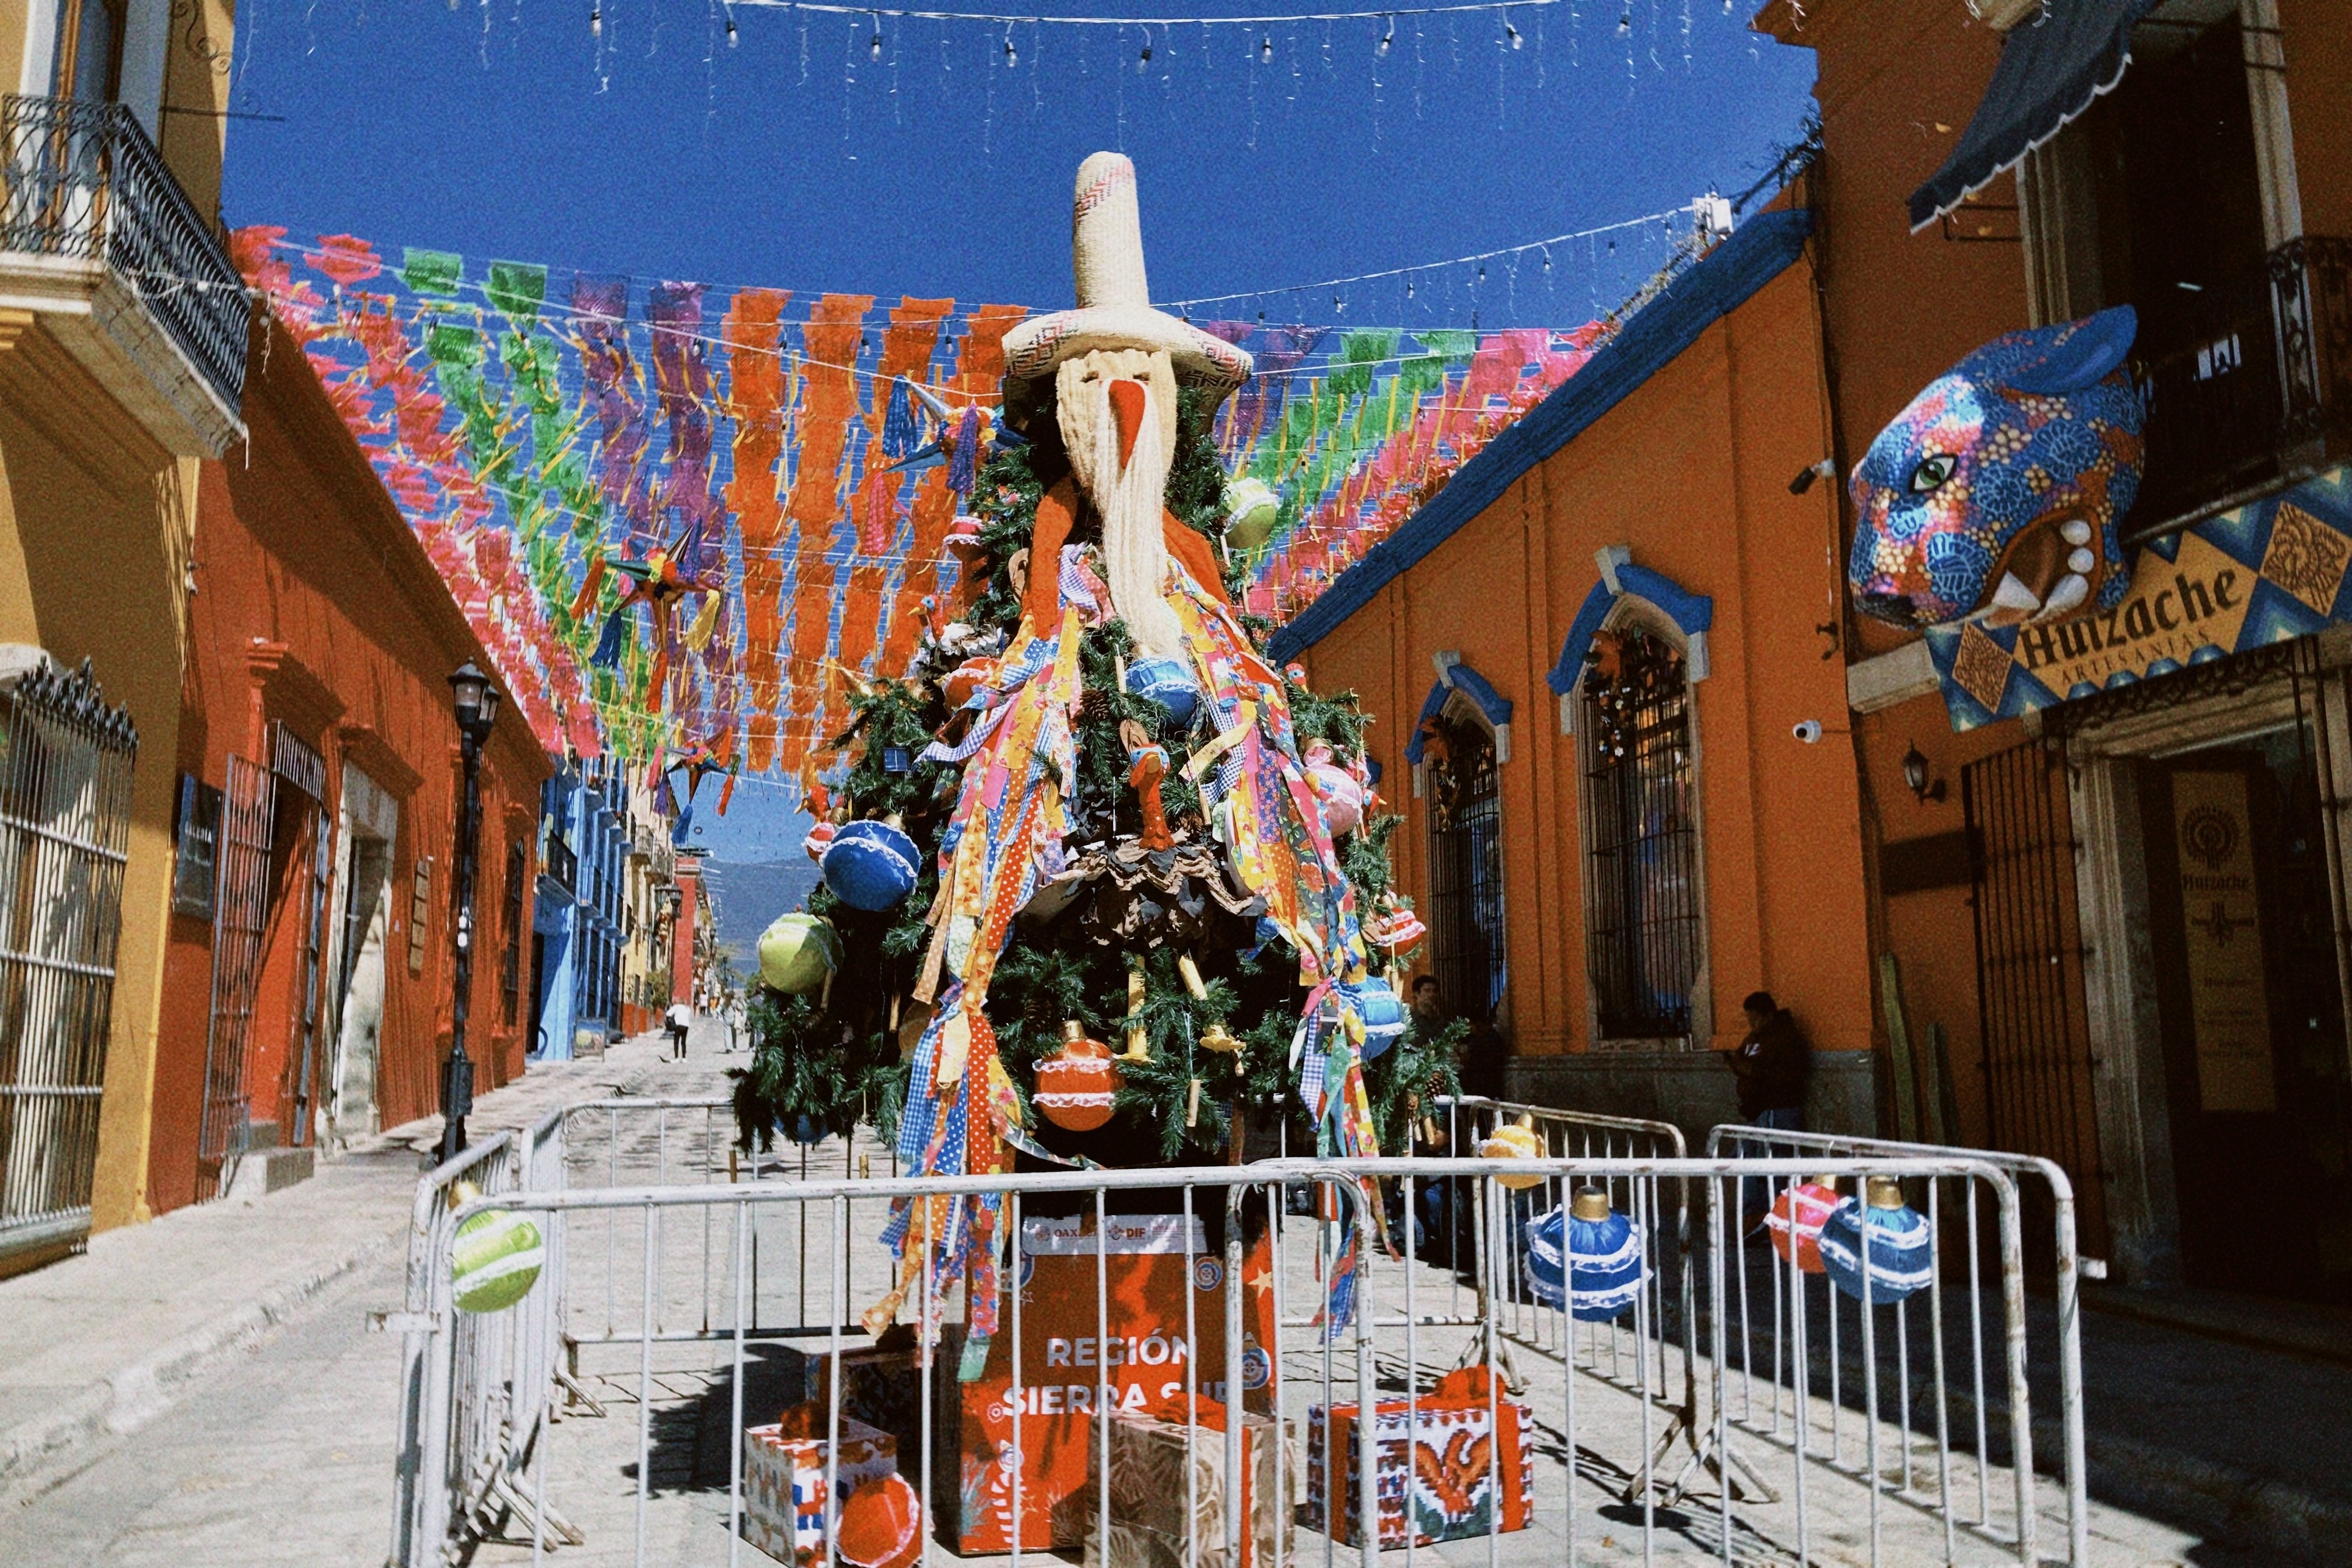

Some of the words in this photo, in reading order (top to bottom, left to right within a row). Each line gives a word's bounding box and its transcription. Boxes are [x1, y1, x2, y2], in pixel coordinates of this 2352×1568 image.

[2020, 568, 2242, 669] Huizache
[1126, 1228, 1145, 1237] DIF
[1047, 1328, 1196, 1367] REGIÓN
[1003, 1383, 1147, 1416] SIERRA
